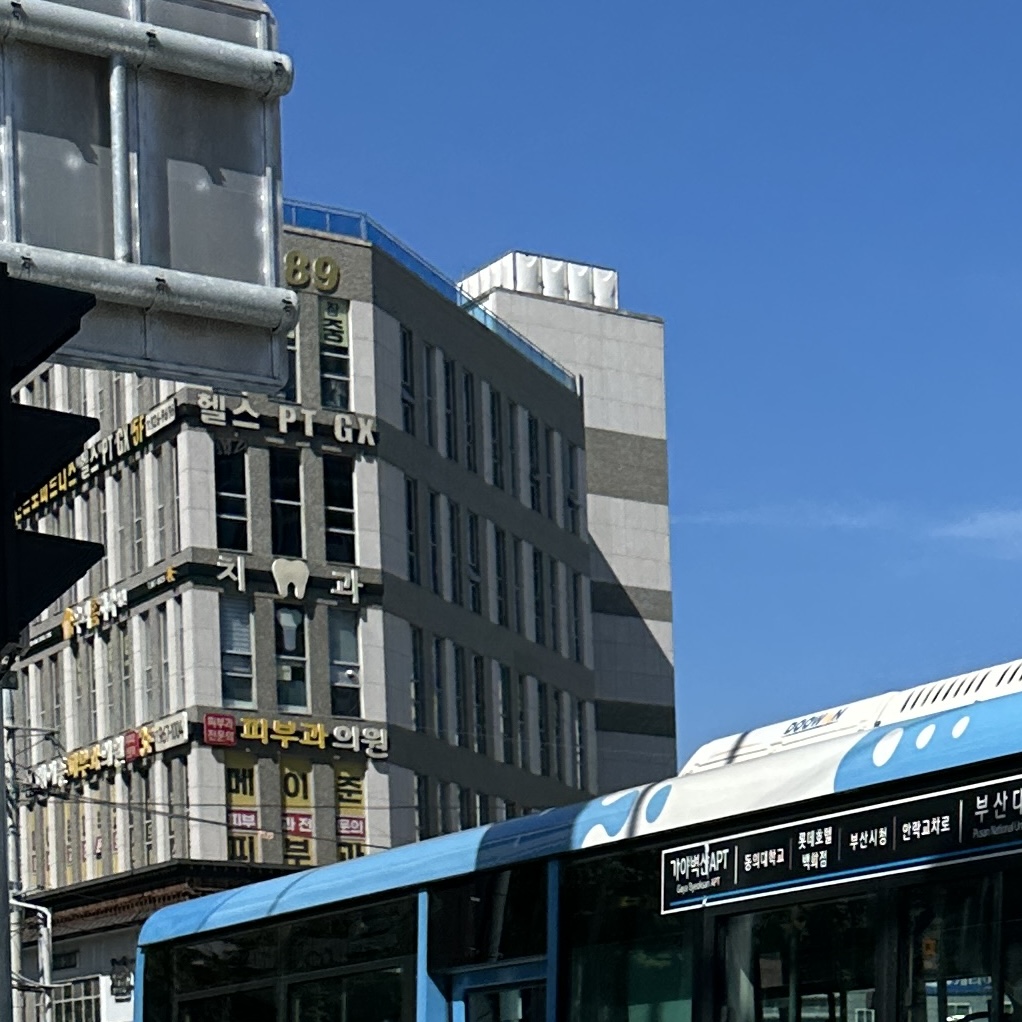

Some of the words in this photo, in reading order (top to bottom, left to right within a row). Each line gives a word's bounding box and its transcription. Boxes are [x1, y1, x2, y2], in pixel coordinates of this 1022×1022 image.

[284, 249, 341, 293] 89
[131, 414, 147, 447] 5F
[197, 391, 261, 431] 헬스
[278, 406, 317, 437] PT
[333, 412, 376, 446] GX
[849, 826, 888, 851] 부산시청
[901, 815, 951, 842] 안락교차로
[669, 848, 730, 882] 가야벽산APT
[743, 847, 785, 873] 동의대학교
[801, 849, 828, 872] 백화점
